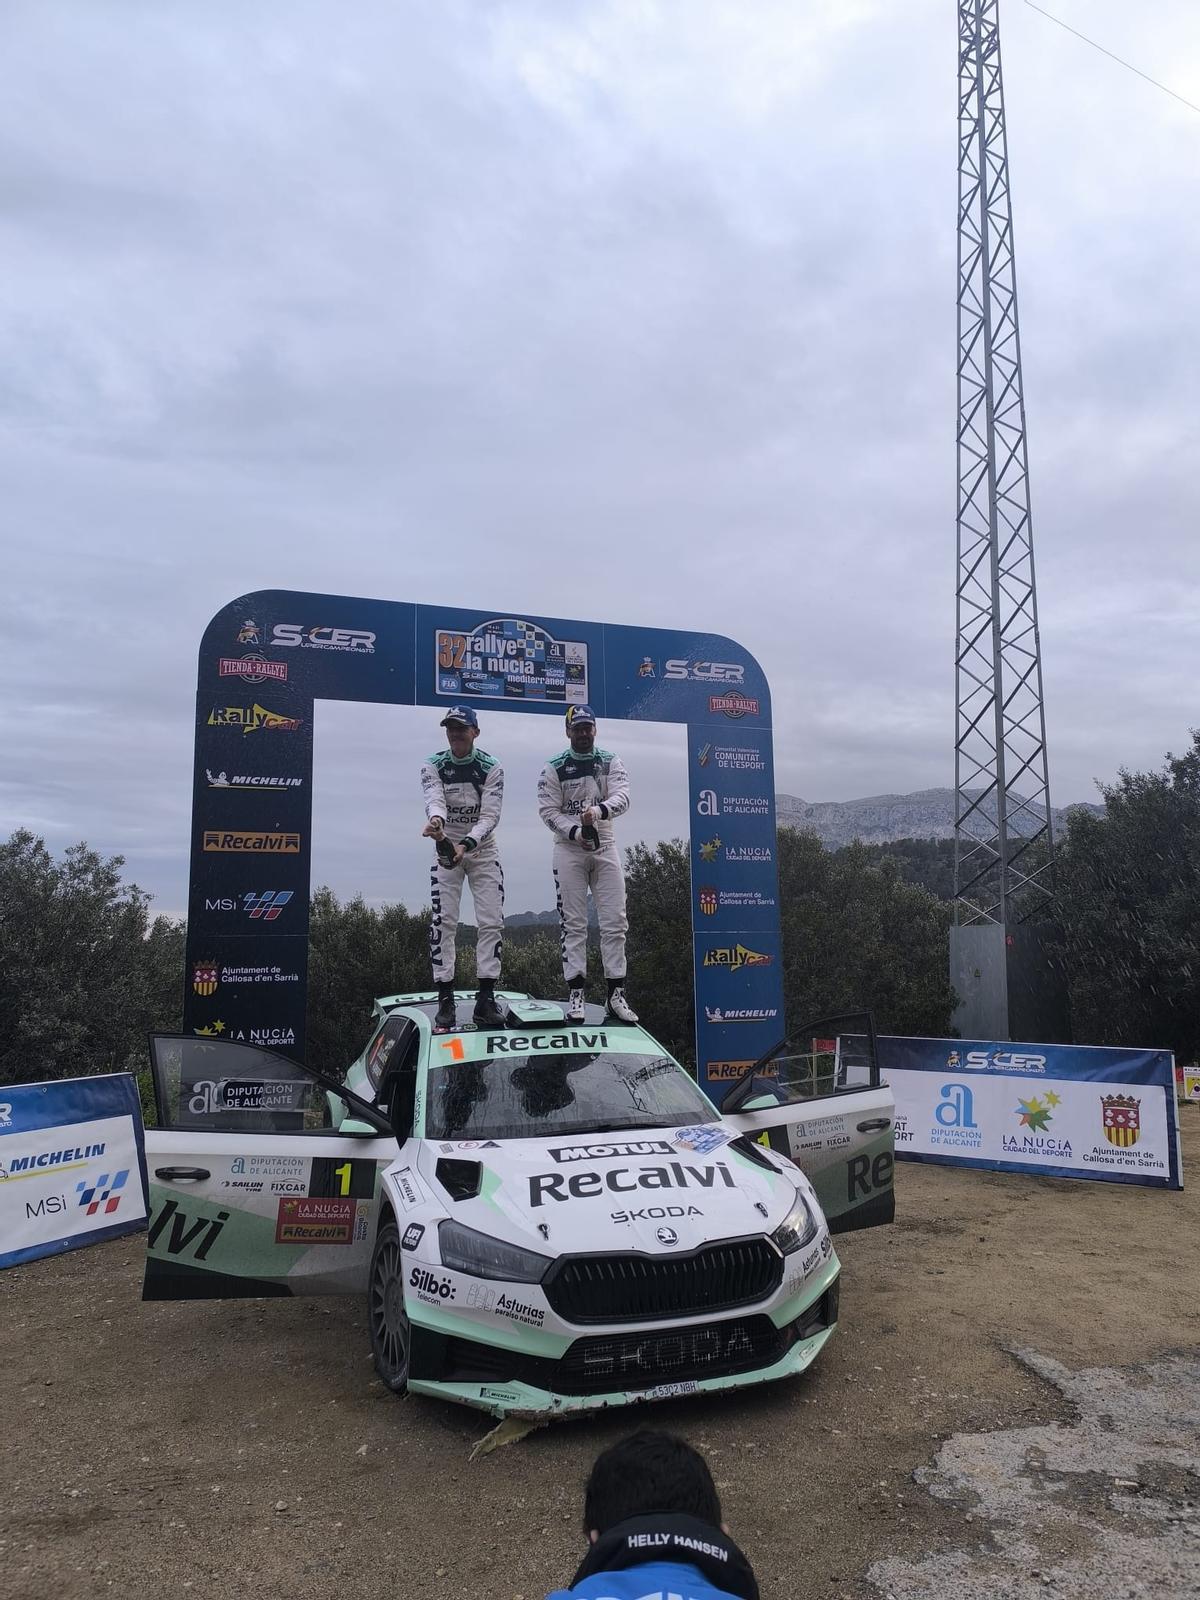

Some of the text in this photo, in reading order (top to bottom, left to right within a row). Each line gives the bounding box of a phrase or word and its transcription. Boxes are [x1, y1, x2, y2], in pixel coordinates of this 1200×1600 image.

[439, 633, 517, 669] 32 rallye
[466, 652, 482, 670] la
[442, 680, 458, 690] FIA
[714, 752, 760, 761] COMUNITAT
[718, 760, 729, 768] DE
[231, 775, 302, 787] MICHELIN
[735, 806, 770, 814] ALICANTE
[221, 834, 285, 850] Recalvi
[725, 847, 737, 856] LA
[720, 891, 753, 899] Ajuntament
[205, 898, 237, 911] MSi
[221, 966, 281, 976] Ajuntament de
[221, 973, 299, 982] Callosa d'en Sarrià
[724, 1009, 777, 1018] MICHELIN
[441, 1031, 609, 1060] 1 Recalvi
[227, 1095, 292, 1108] DE ALICANTE
[809, 1124, 845, 1137] DE ALICANTE
[827, 1136, 851, 1147] FIXCAR
[943, 1138, 982, 1148] ALICANTE
[1002, 1135, 1018, 1146] LA
[9, 1143, 106, 1172] MICHELIN
[559, 1141, 670, 1161] MOTUL
[1002, 1145, 1073, 1158] CIUDAD DEL DEPORTE
[1092, 1146, 1154, 1159] Ajuntament de
[1082, 1154, 1115, 1164] Callosa
[1116, 1157, 1136, 1166] d'en
[250, 1167, 304, 1176] DE ALICANTE
[335, 1163, 352, 1196] 1
[528, 1161, 738, 1208] Recalvi
[271, 1183, 306, 1193] FIXCAR
[401, 1177, 417, 1203] MICHELIN
[25, 1194, 67, 1219] MSi
[298, 1204, 310, 1213] LA
[147, 1199, 230, 1261] lvi
[294, 1226, 337, 1238] Recalvi
[406, 1227, 422, 1240] UFI
[417, 1291, 441, 1306] Telecom
[497, 1293, 545, 1320] Asturias
[519, 1315, 544, 1328] natural
[628, 1533, 728, 1562] HELLY HANSEN
